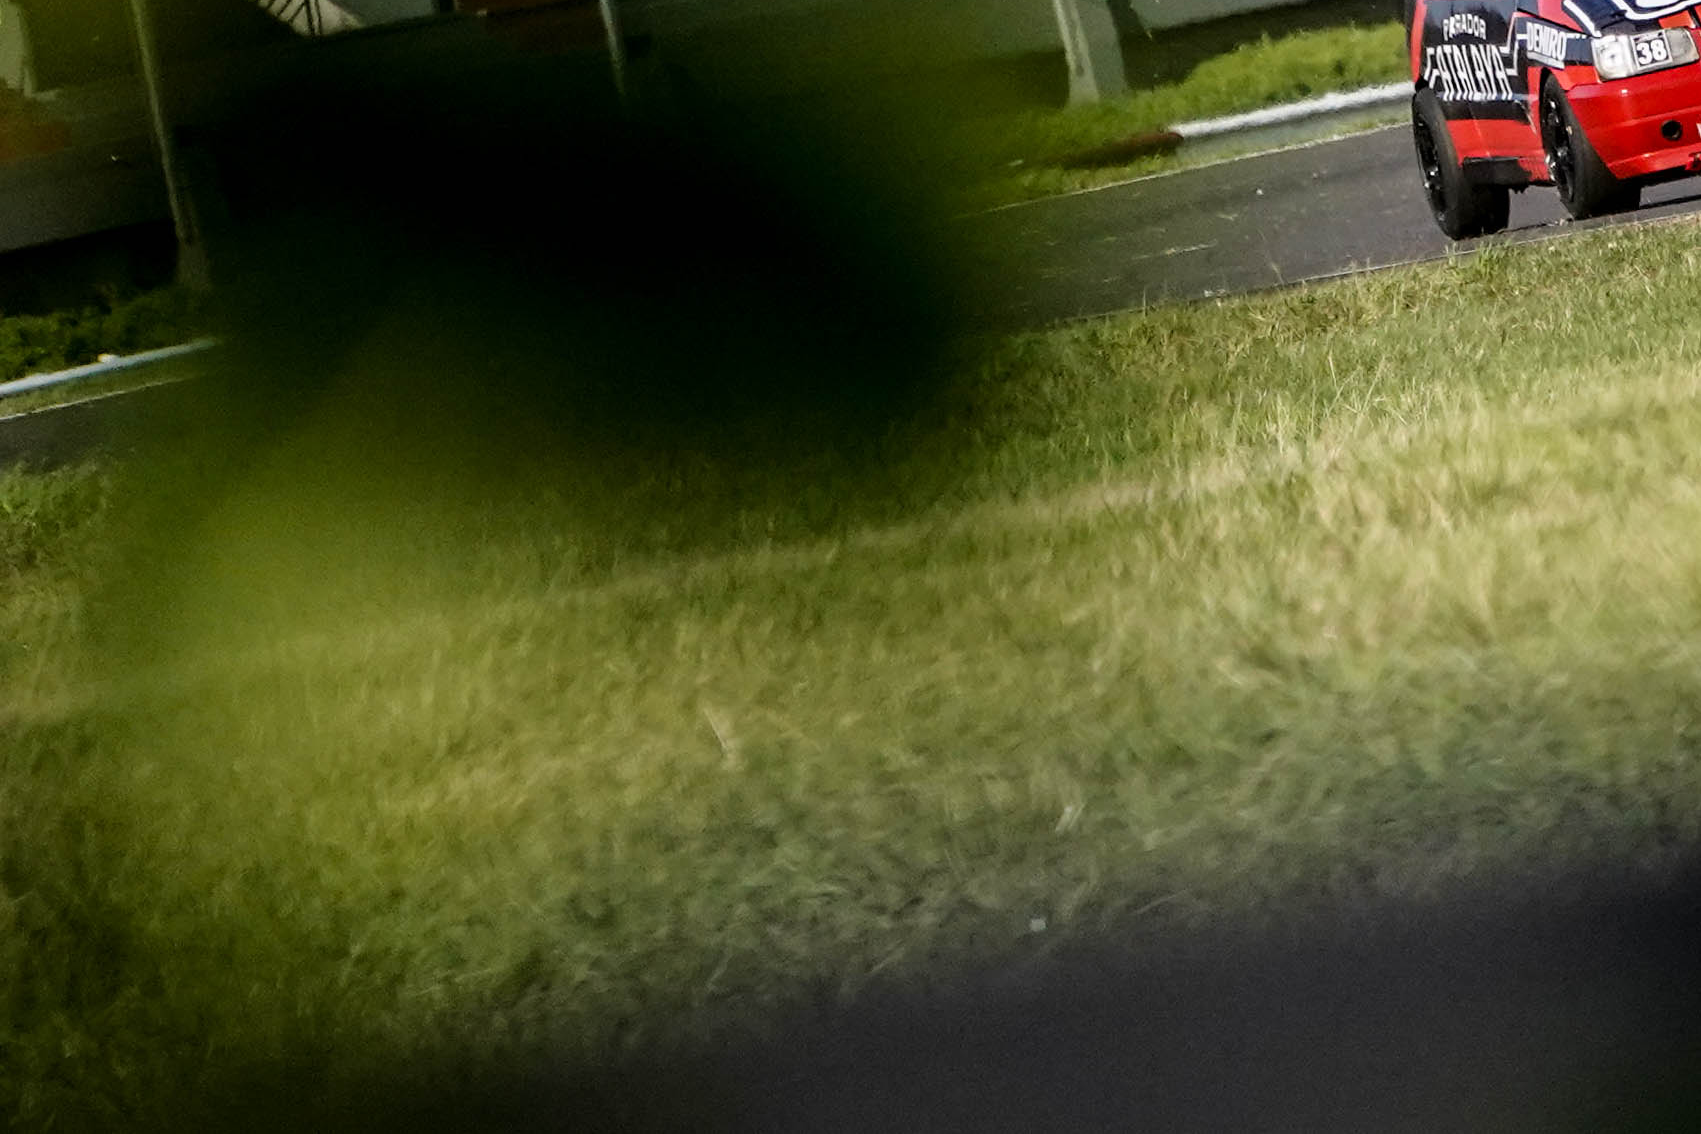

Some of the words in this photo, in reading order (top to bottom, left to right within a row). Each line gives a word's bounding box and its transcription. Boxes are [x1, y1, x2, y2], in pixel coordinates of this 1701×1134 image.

[1443, 13, 1486, 41] PARADOR
[1526, 22, 1567, 61] DENIRO
[1636, 39, 1667, 65] 38
